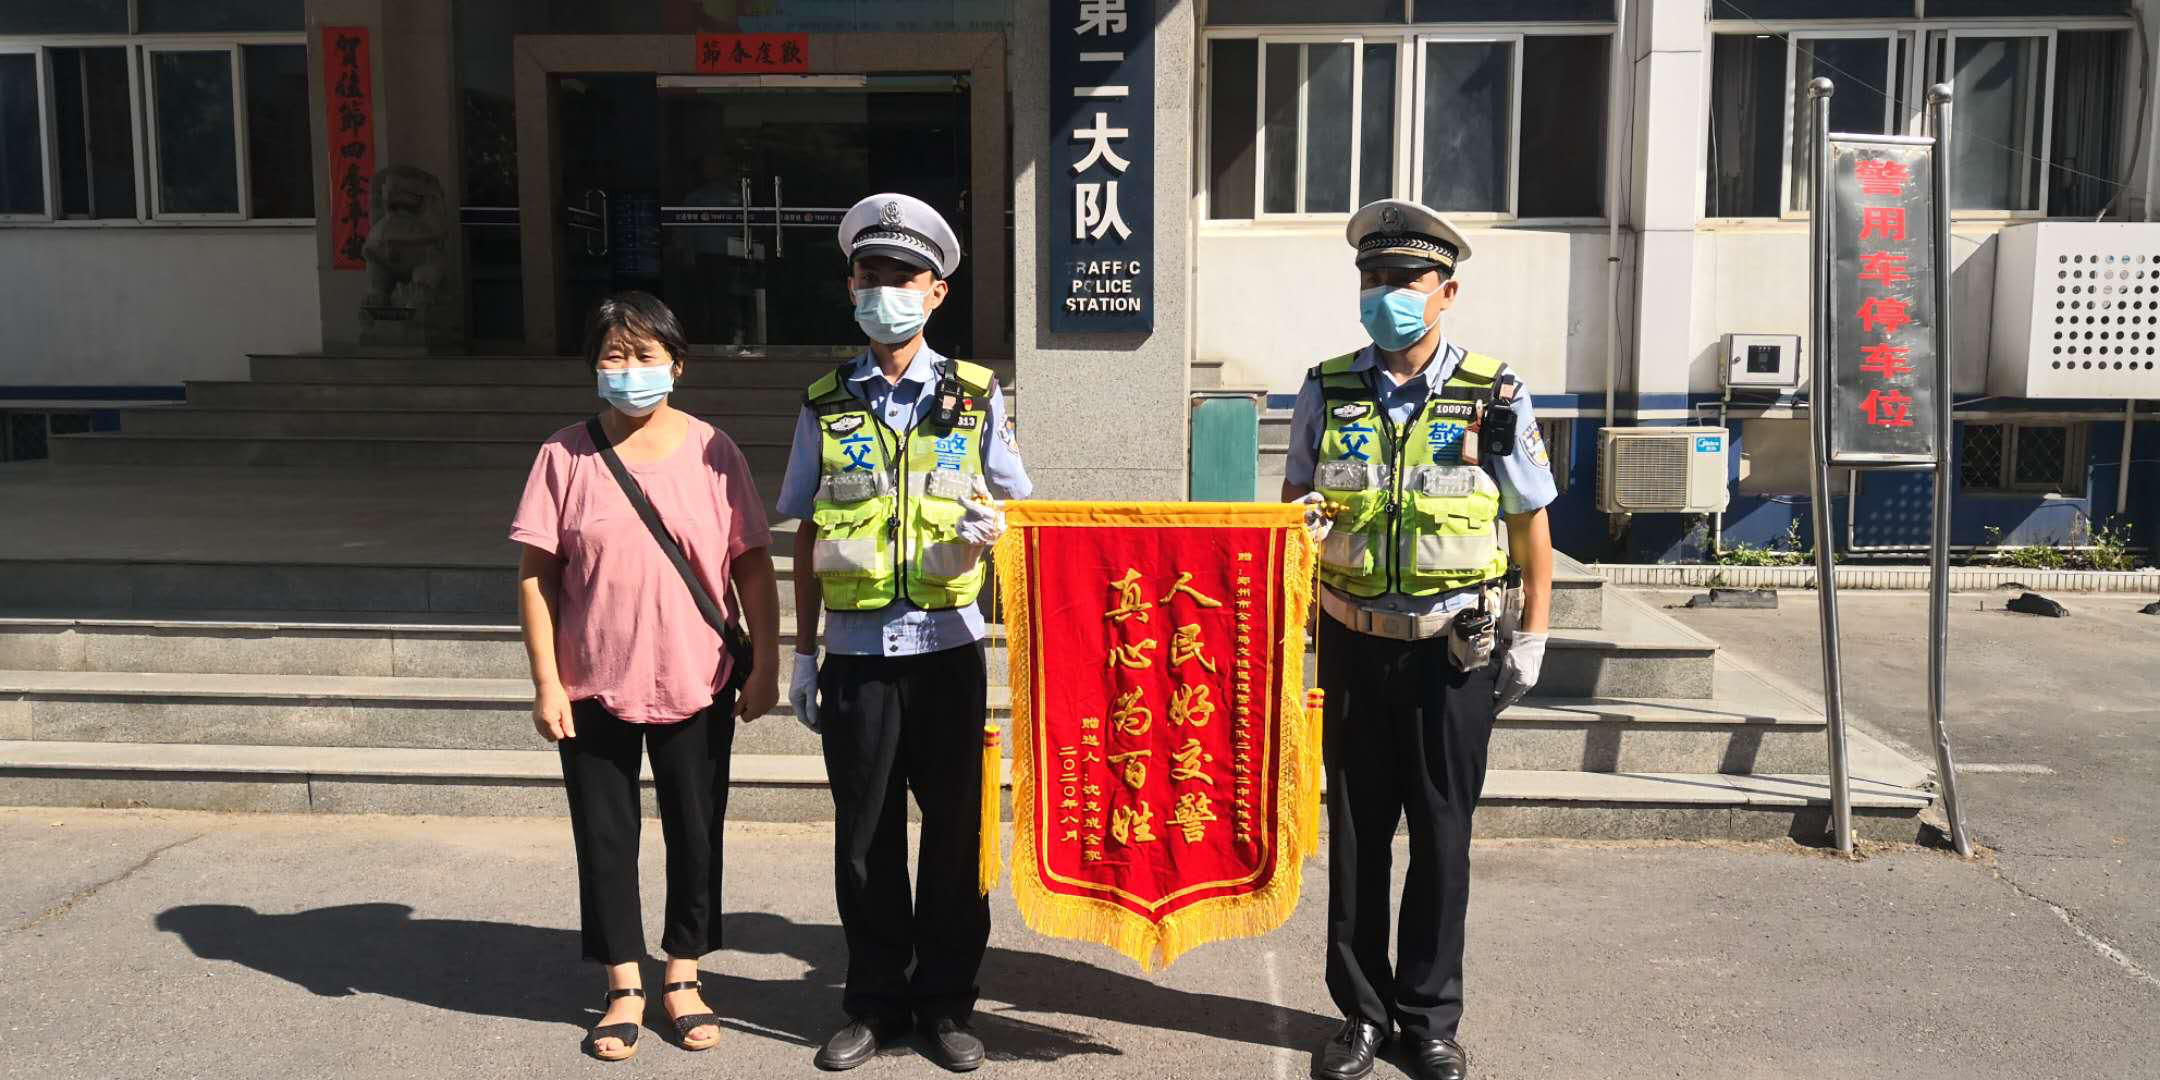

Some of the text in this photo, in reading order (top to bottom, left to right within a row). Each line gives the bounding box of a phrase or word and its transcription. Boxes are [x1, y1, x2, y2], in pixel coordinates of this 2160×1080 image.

[1072, 0, 1132, 240] 第二大队
[1065, 297, 1141, 311] STATION
[1072, 279, 1132, 293] POLICE
[1855, 160, 1914, 427] 警用车停车位
[839, 433, 967, 472] 交 警
[1338, 422, 1466, 463] 交 警
[1104, 568, 1157, 845] 真心为百姓
[1159, 571, 1222, 843] 人民好交警
